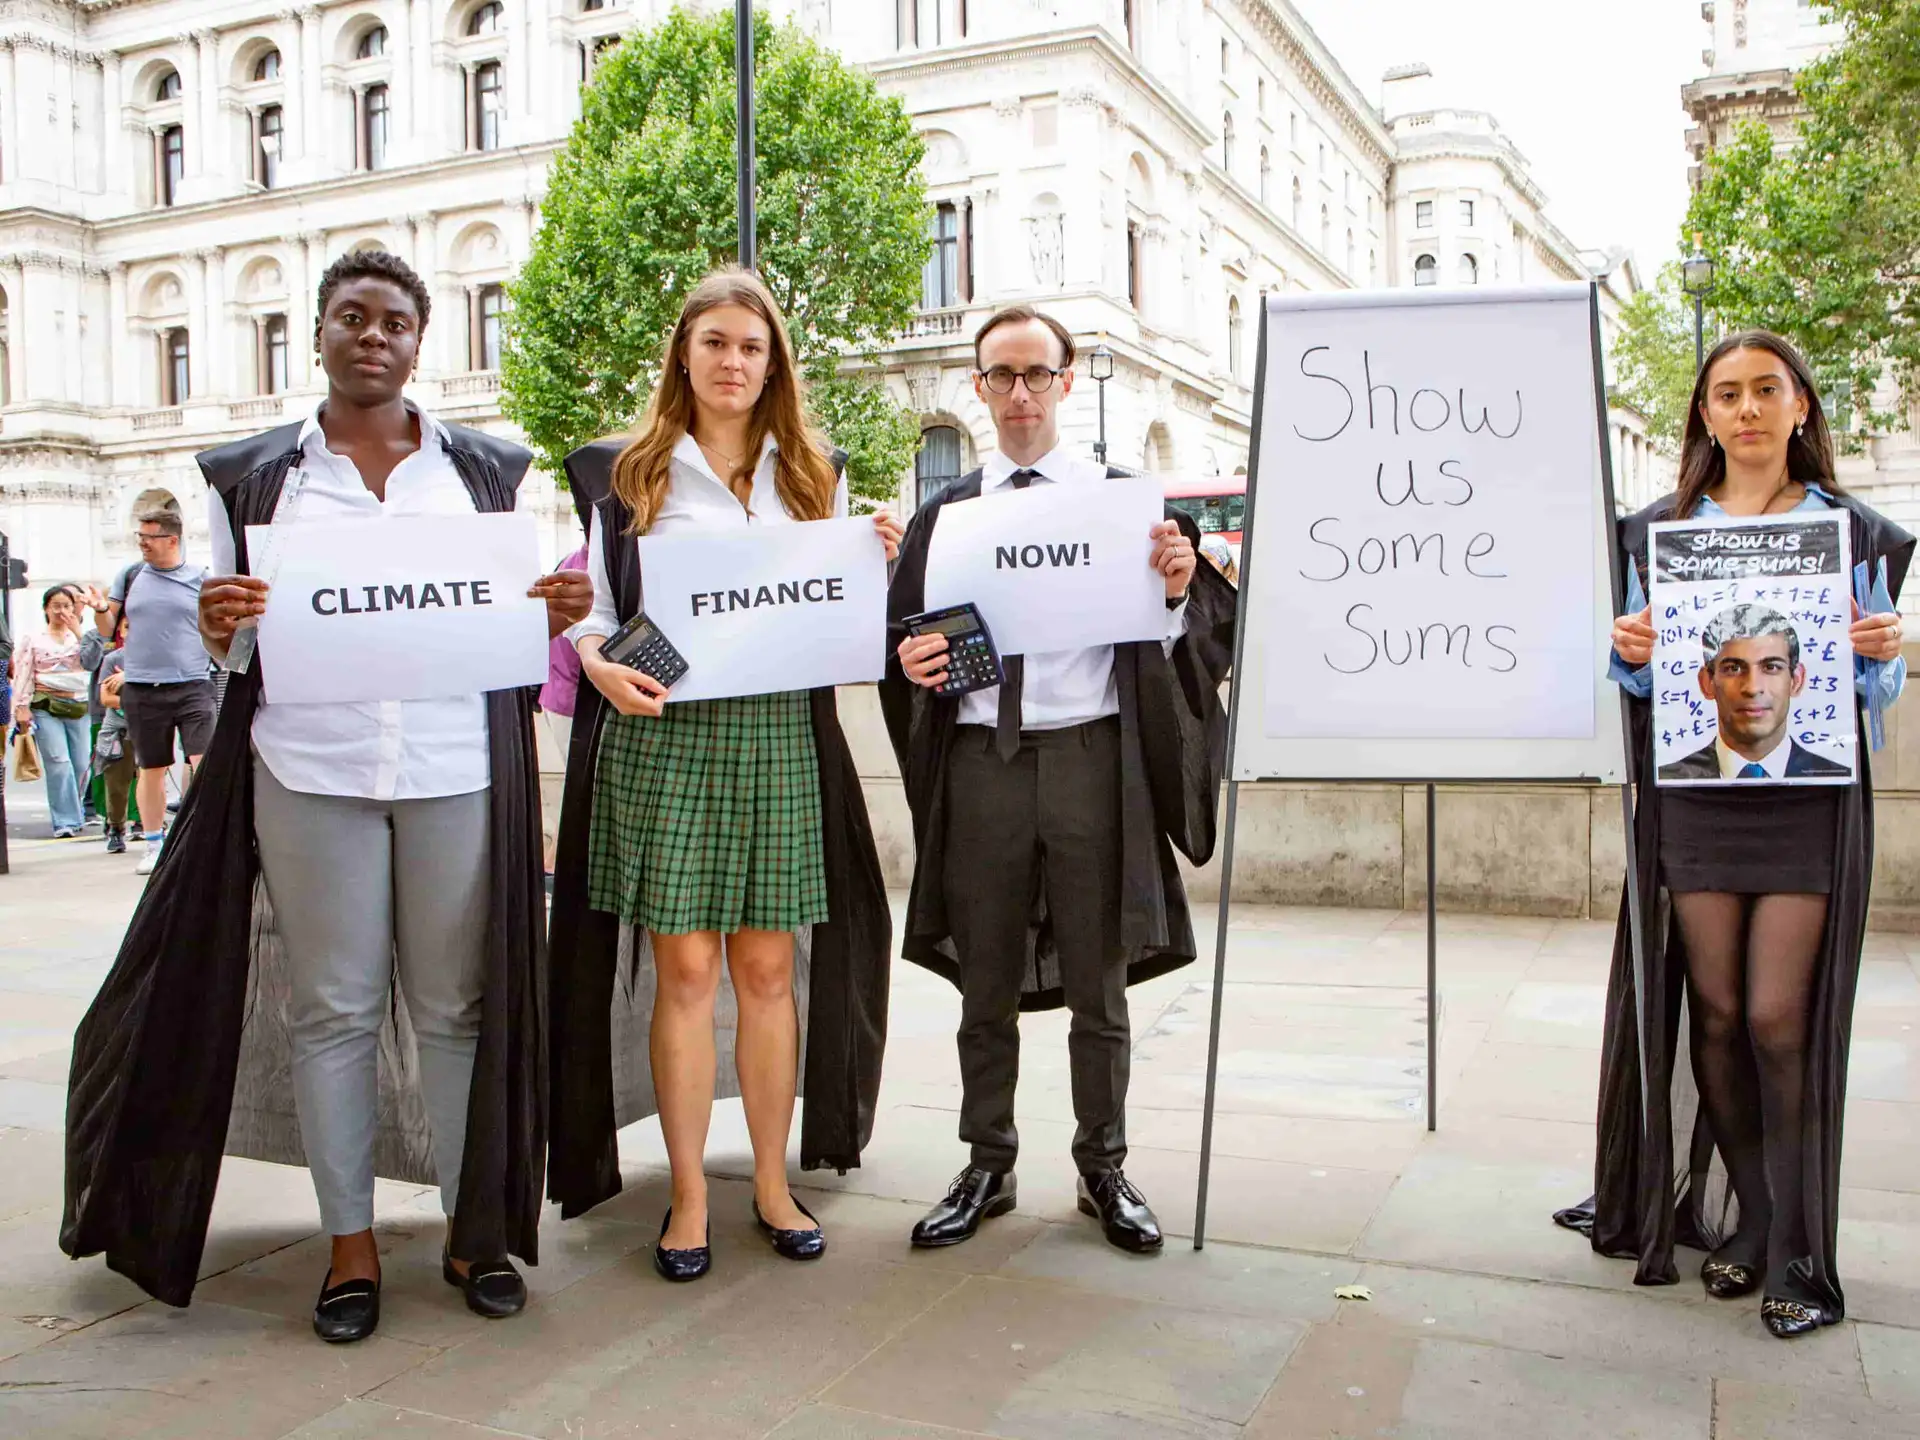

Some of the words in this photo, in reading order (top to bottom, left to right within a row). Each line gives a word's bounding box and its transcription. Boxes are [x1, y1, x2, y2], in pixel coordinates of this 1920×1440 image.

[1294, 346, 1521, 441] Show
[1376, 460, 1473, 506] us
[996, 542, 1091, 569] NOW!
[1299, 517, 1507, 581] Some
[1691, 529, 1765, 551] show
[1766, 533, 1801, 551] us
[1668, 555, 1740, 575] some
[1744, 552, 1825, 574] sums!
[311, 580, 493, 616] CLIMATE
[691, 578, 844, 617] FINANCE
[1324, 603, 1517, 673] Sums
